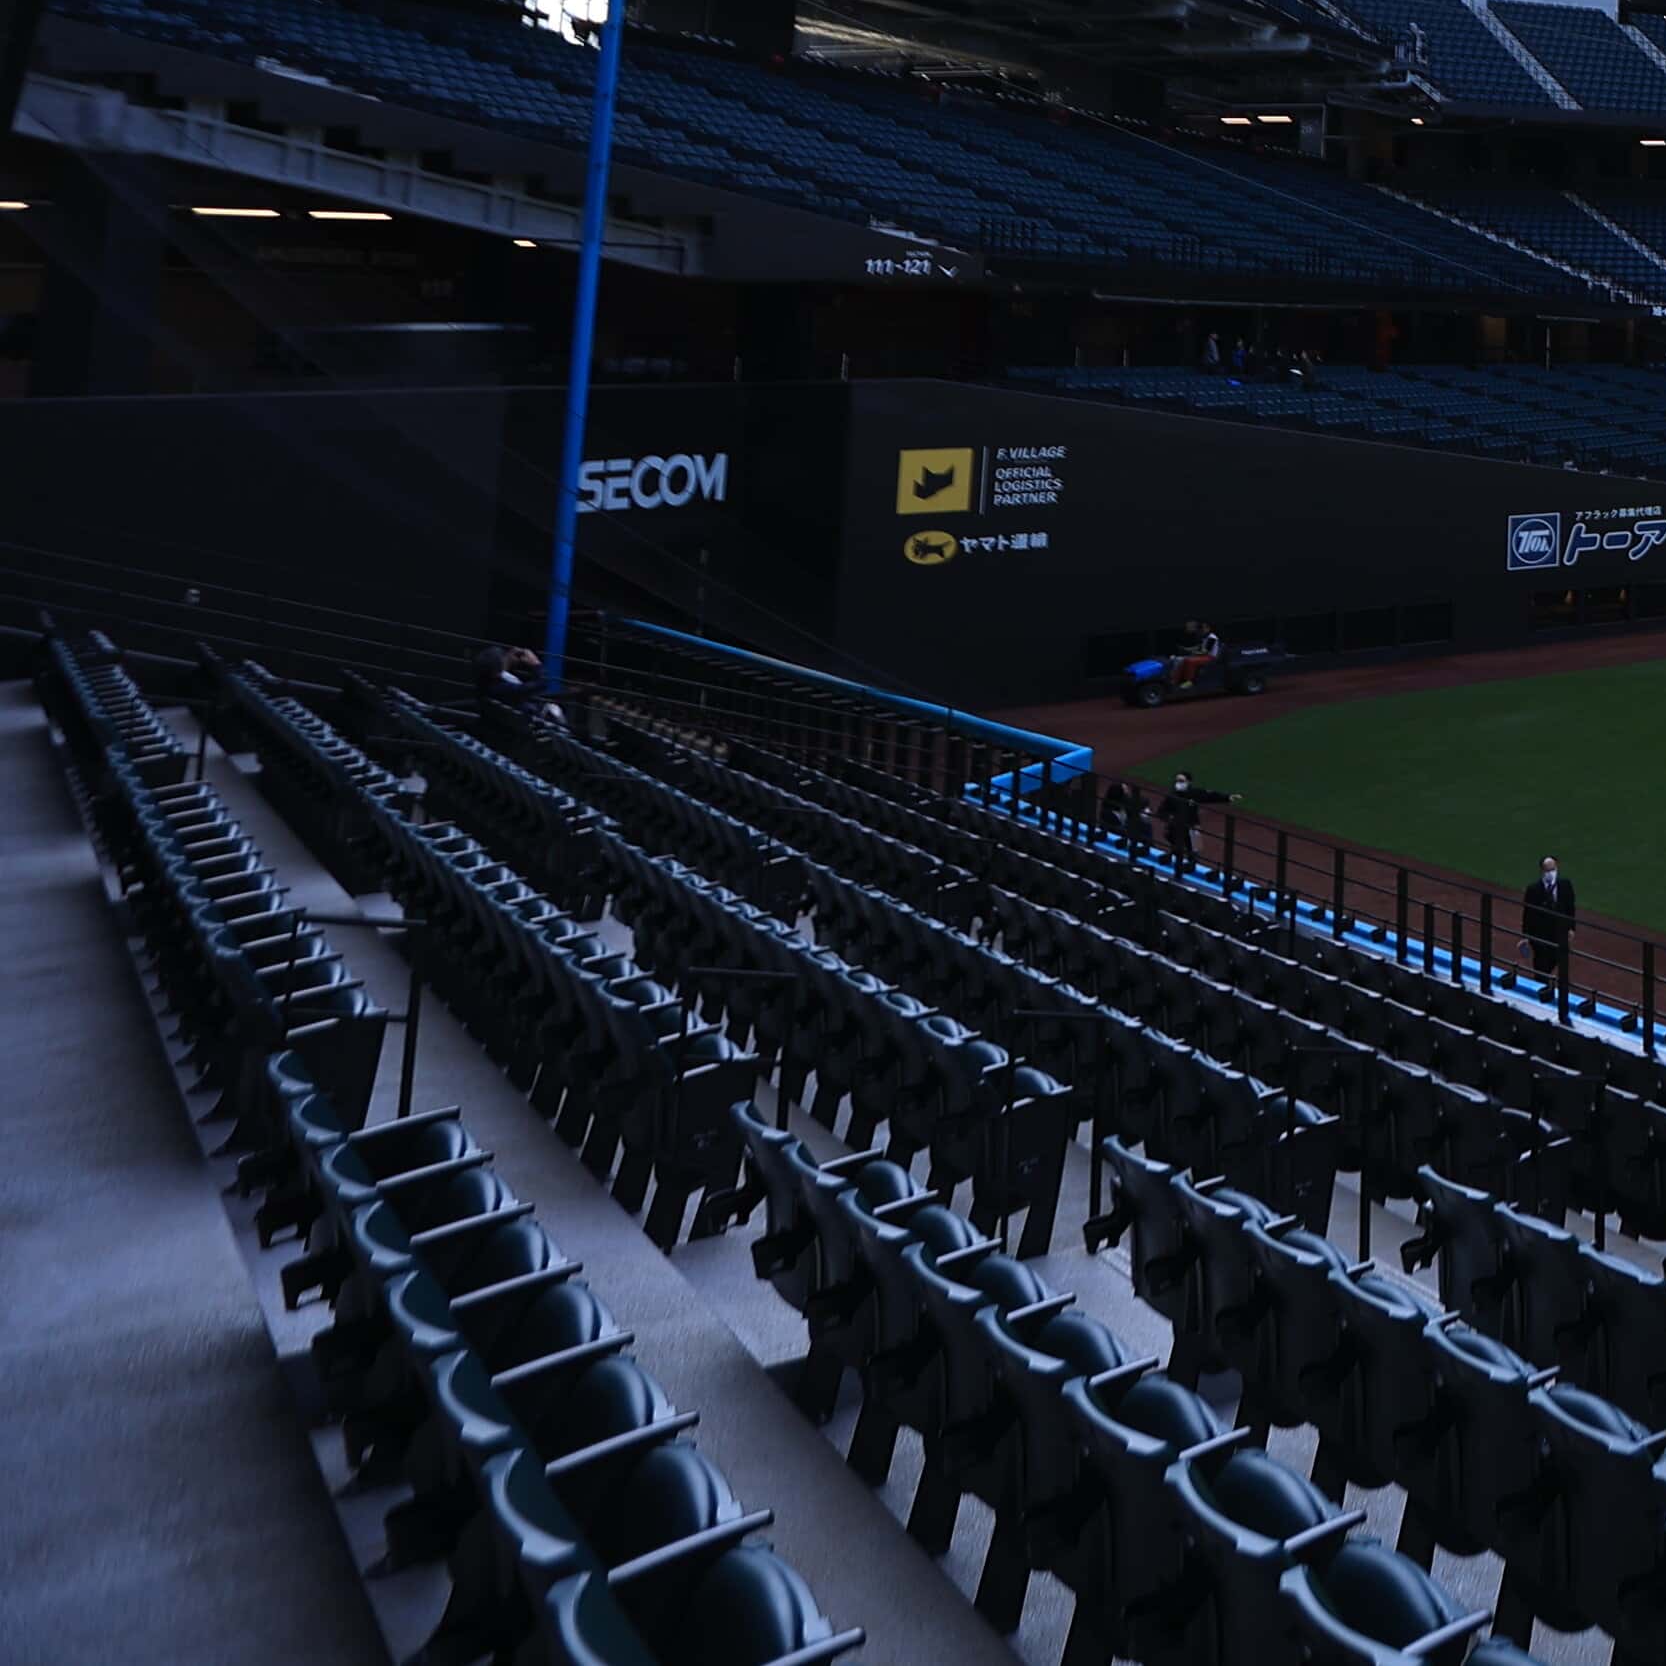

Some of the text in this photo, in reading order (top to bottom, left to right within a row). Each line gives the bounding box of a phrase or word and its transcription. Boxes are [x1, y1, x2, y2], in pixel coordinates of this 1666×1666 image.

[865, 258, 932, 277] 111-121
[1009, 445, 1067, 460] VILLAGE
[995, 465, 1053, 480] OFFICIAL
[575, 452, 730, 514] SECOM
[994, 479, 1064, 494] LOGISTICS
[993, 491, 1059, 506] PARTNER
